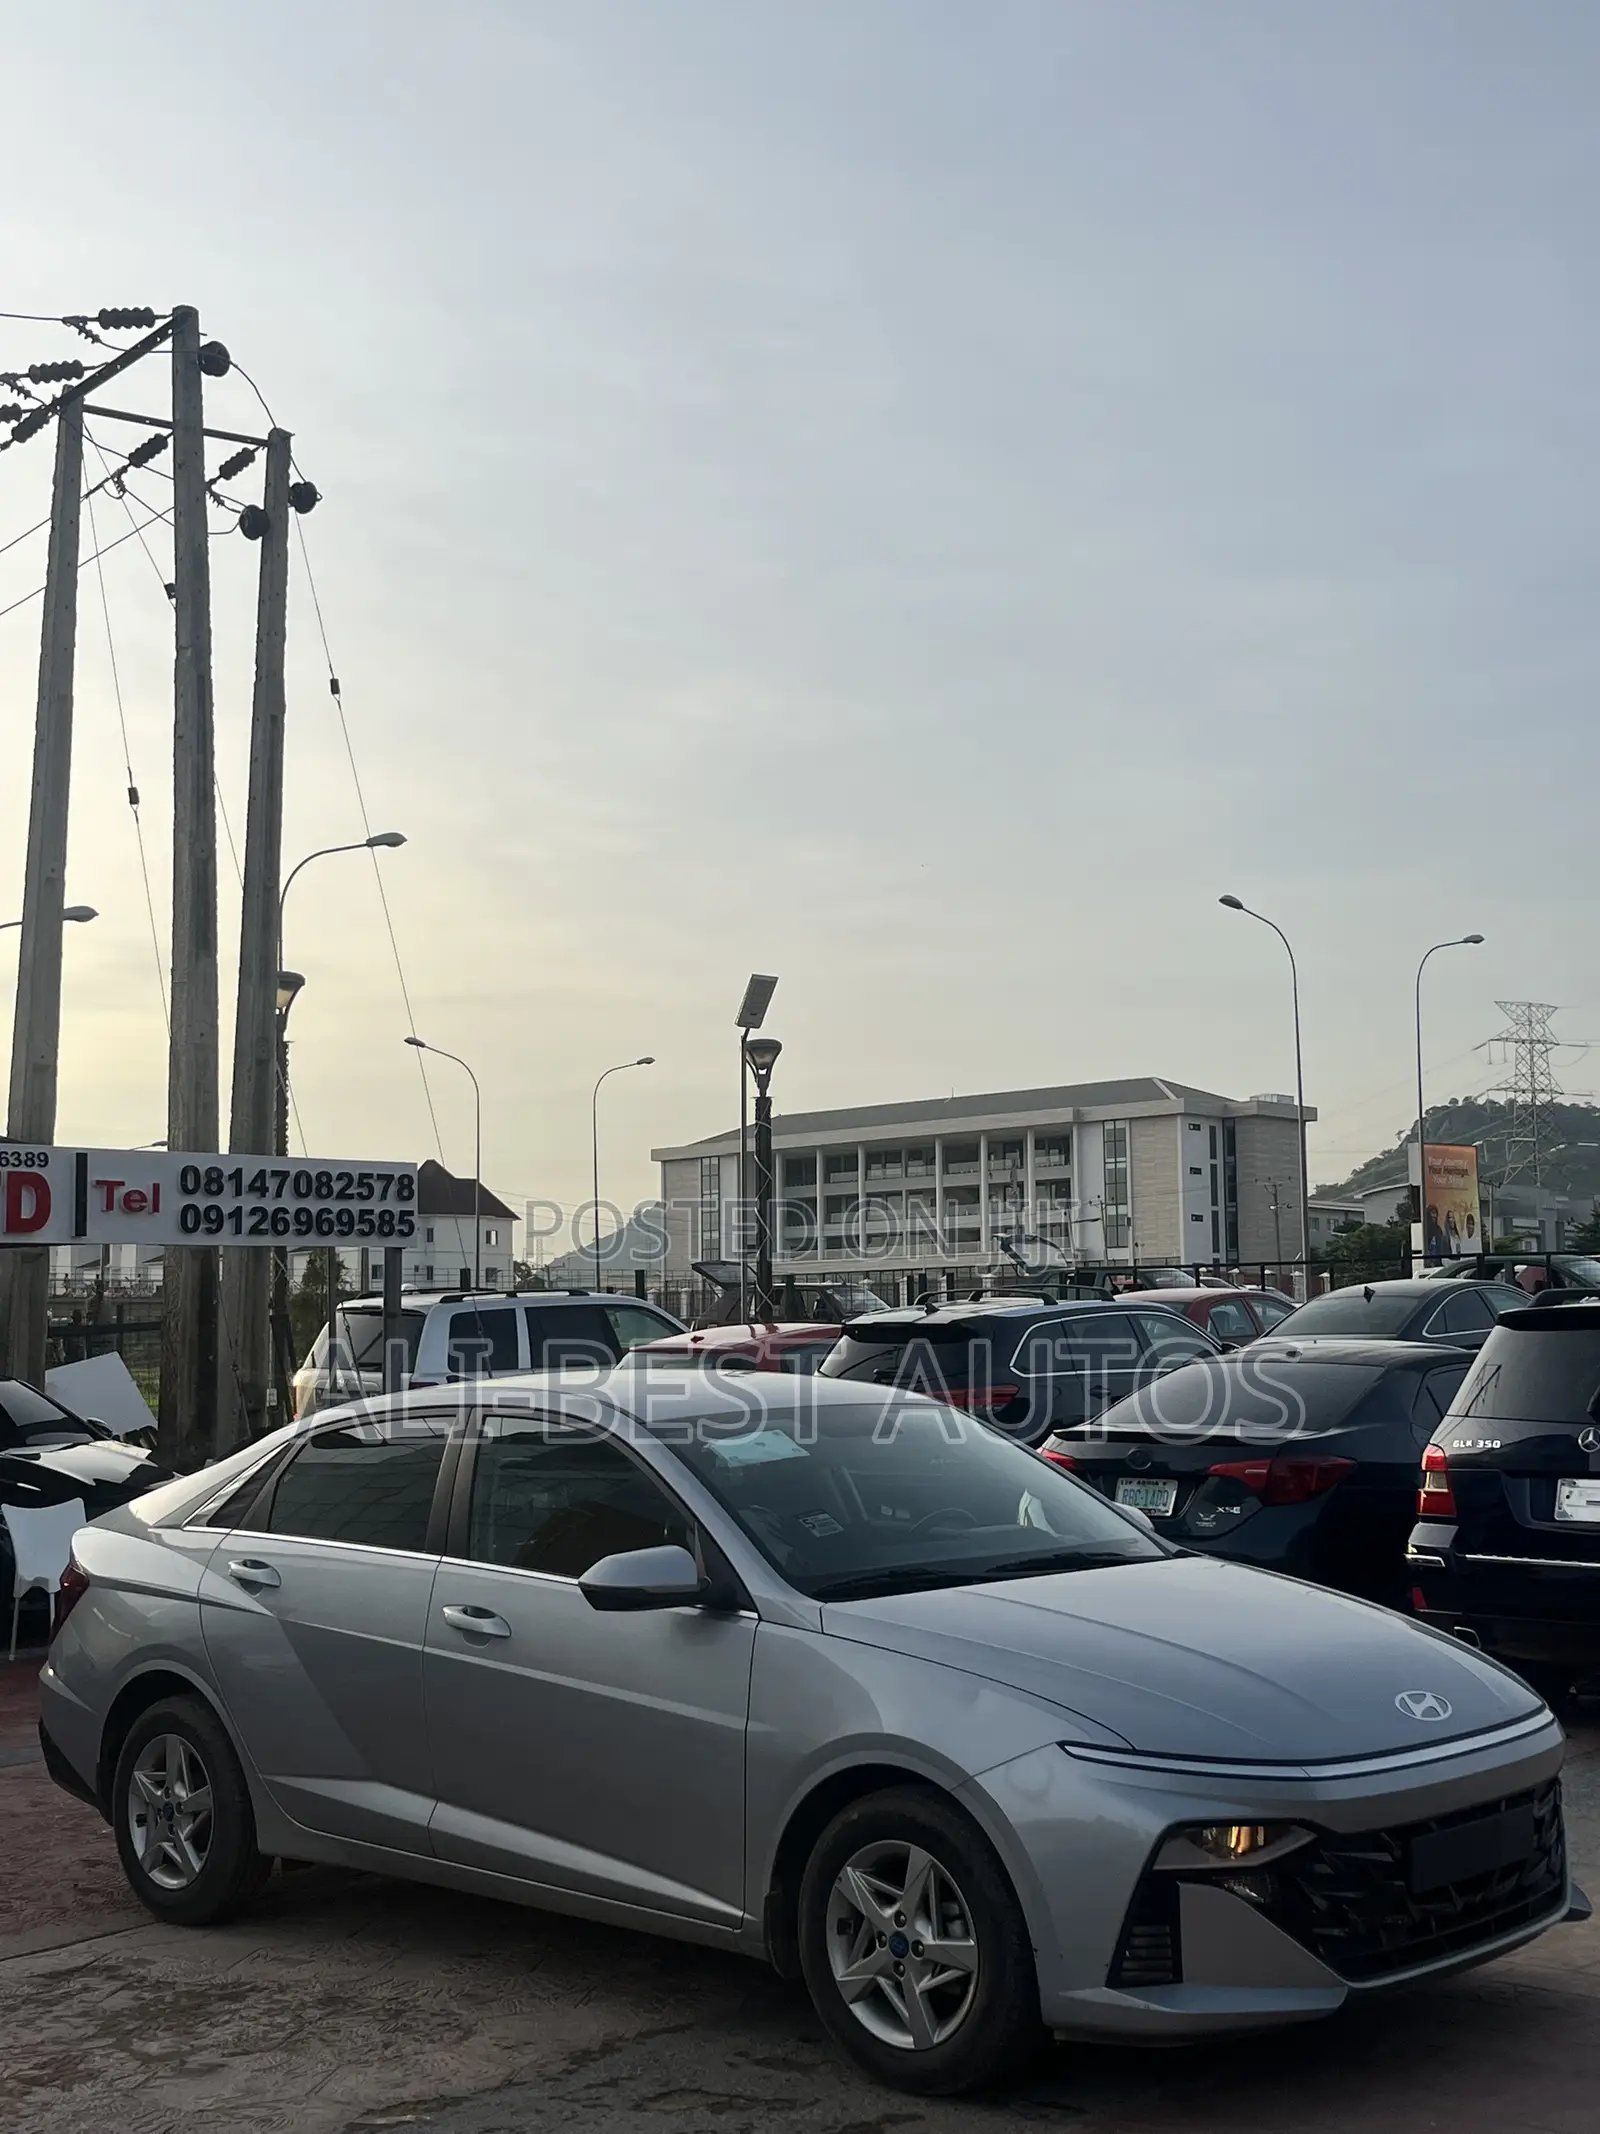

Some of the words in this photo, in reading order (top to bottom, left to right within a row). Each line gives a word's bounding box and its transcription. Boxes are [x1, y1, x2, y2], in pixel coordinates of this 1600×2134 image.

[0, 1151, 49, 1168] 6389
[94, 1179, 160, 1213] Tel
[180, 1165, 415, 1201] 08147082578
[180, 1204, 415, 1237] 09126969585
[1452, 1440, 1473, 1448] GLK
[1476, 1440, 1501, 1448] 350
